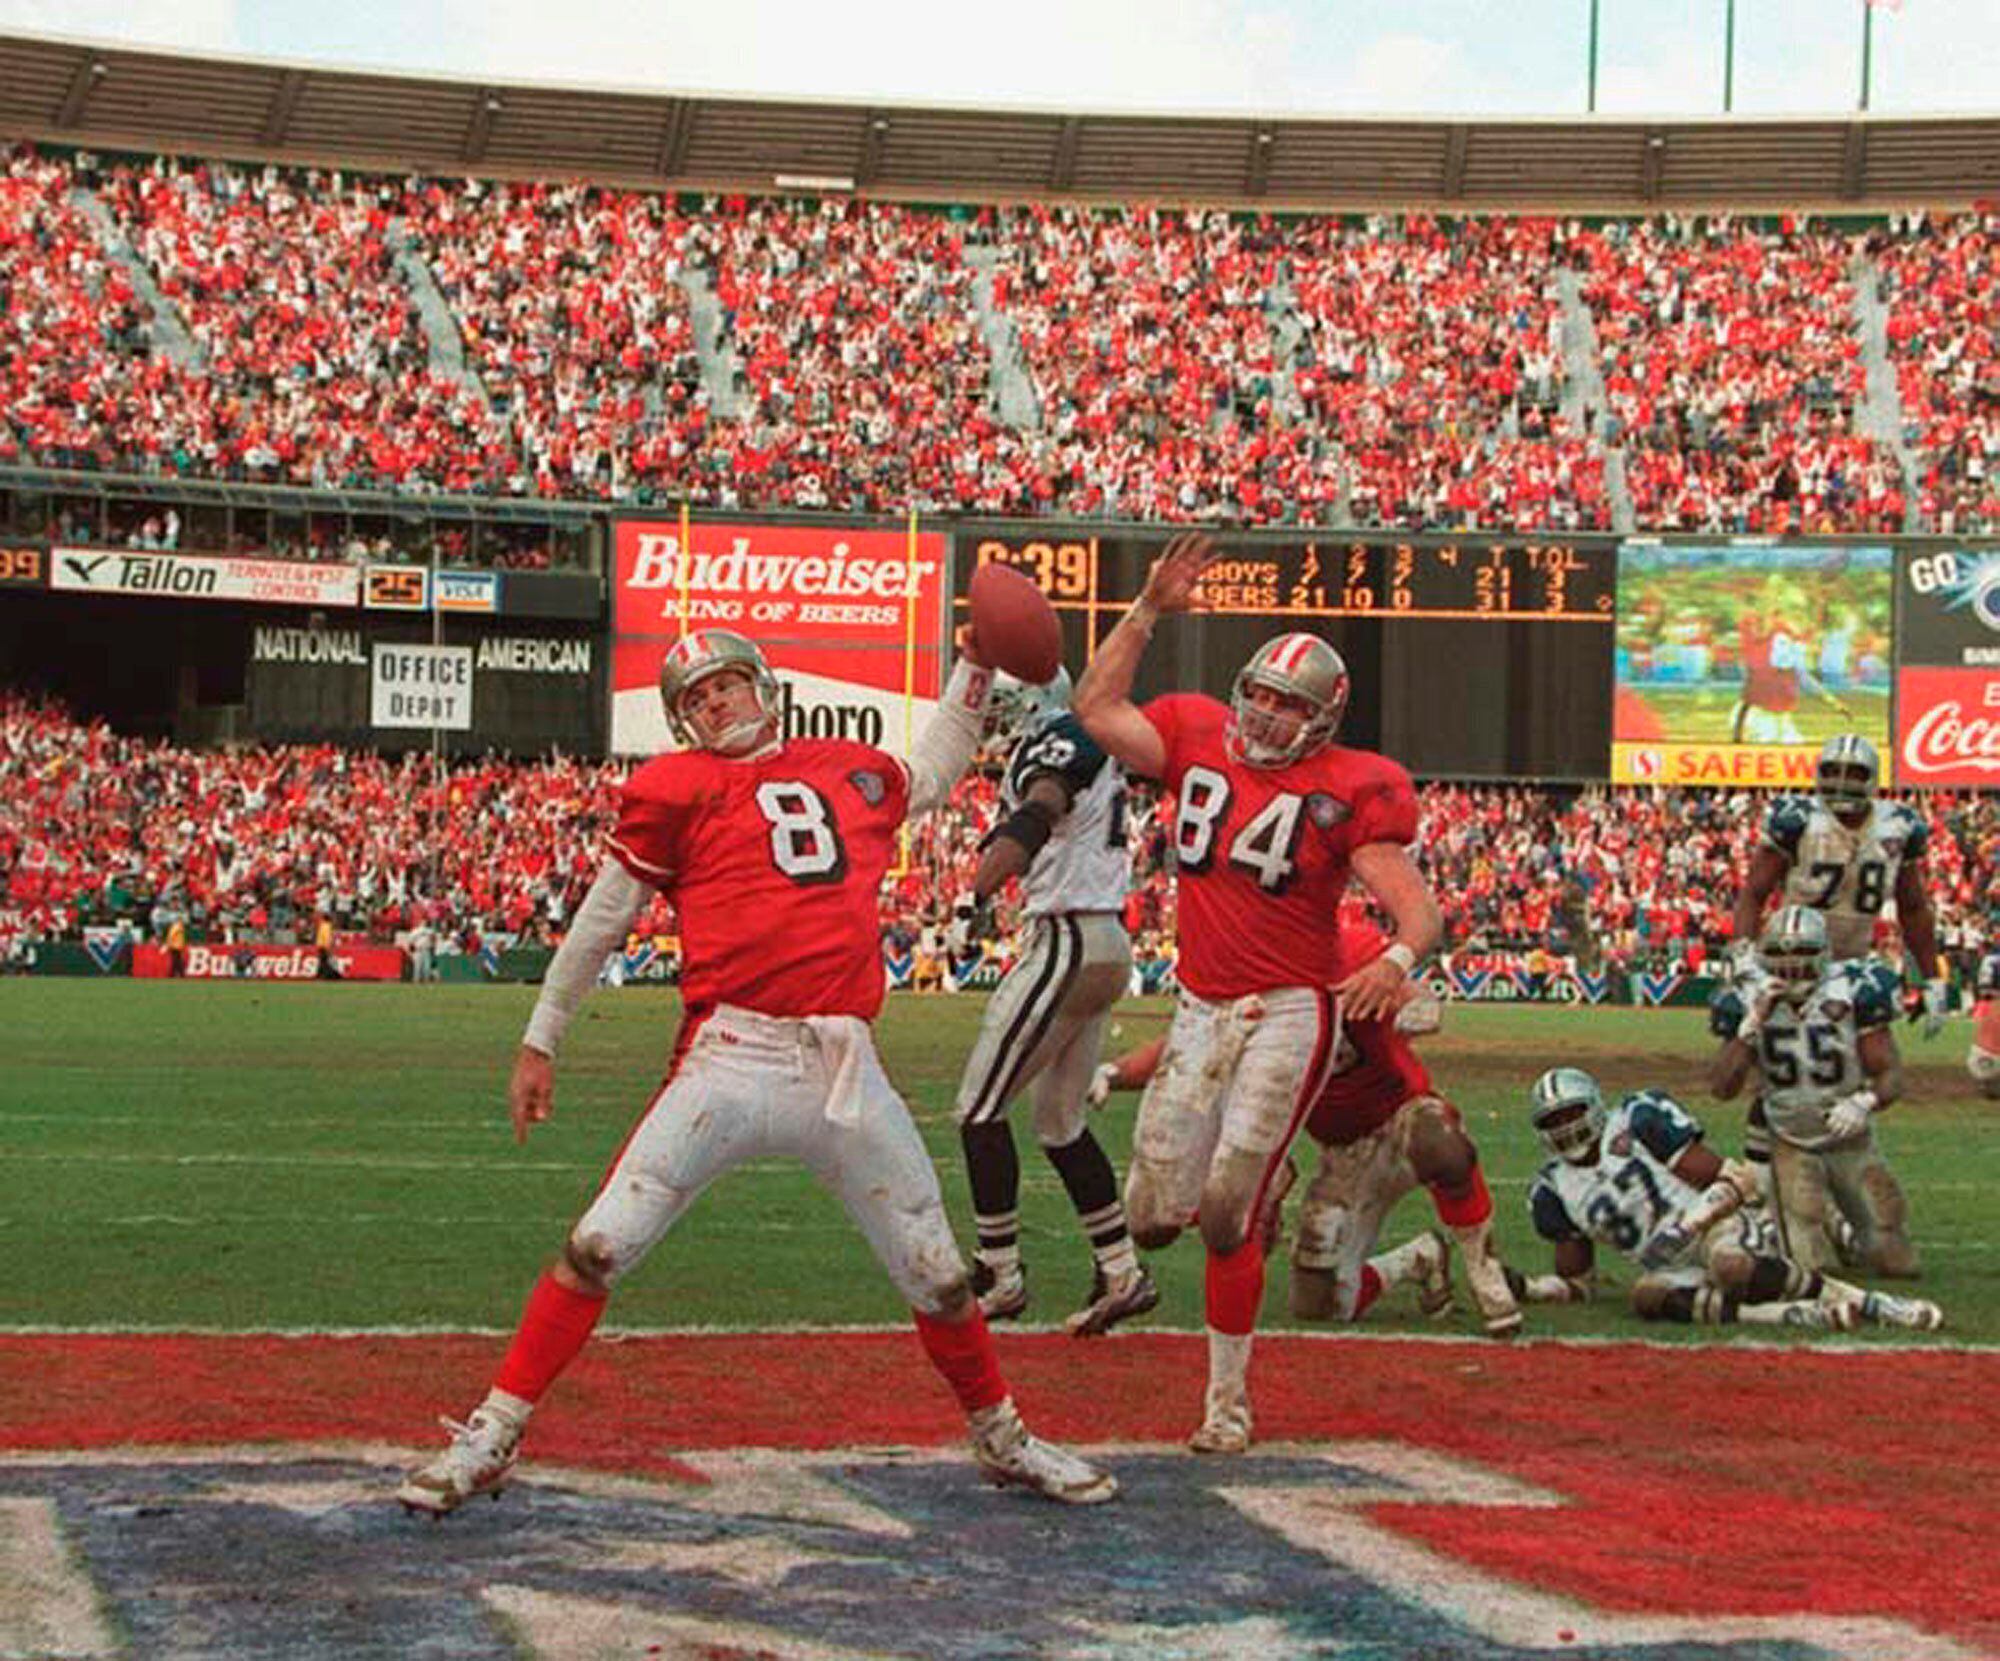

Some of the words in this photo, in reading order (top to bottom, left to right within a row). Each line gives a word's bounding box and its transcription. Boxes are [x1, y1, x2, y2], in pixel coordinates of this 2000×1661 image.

[119, 556, 217, 593] Tallon
[627, 533, 935, 599] Budweiser
[1910, 552, 1957, 594] GO
[662, 600, 741, 620] KING
[750, 601, 794, 622] OF
[799, 605, 899, 625] BEERS
[1290, 586, 1327, 609] 21
[253, 626, 367, 665] NATIONAL
[476, 638, 592, 673] AMERICAN
[378, 652, 468, 685] OFFICE
[390, 691, 457, 720] DEPOT
[782, 682, 882, 748] boro
[1676, 750, 1822, 781] SAFEW
[756, 781, 844, 880] 8
[1176, 765, 1304, 890] 84
[1808, 861, 1887, 914] 78
[186, 948, 353, 978] Buweisr
[1763, 1024, 1845, 1086] 55
